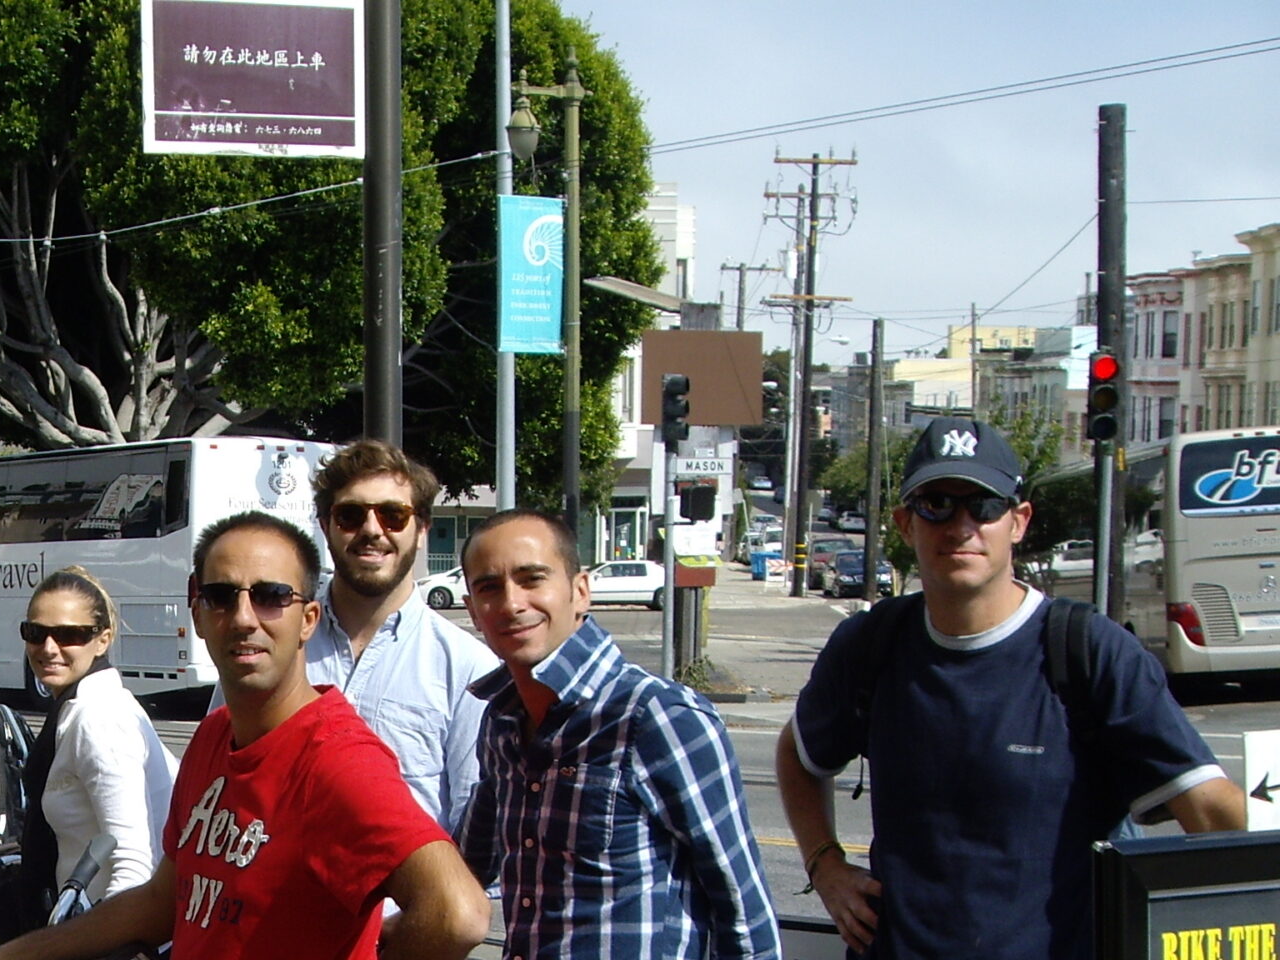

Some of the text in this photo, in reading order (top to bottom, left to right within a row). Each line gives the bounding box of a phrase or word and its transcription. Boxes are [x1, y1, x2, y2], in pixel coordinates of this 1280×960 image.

[183, 43, 326, 71] 請勿在此地區上車
[941, 429, 978, 457] NY
[685, 461, 724, 471] MASON
[177, 776, 270, 868] Aero
[185, 873, 223, 928] NY
